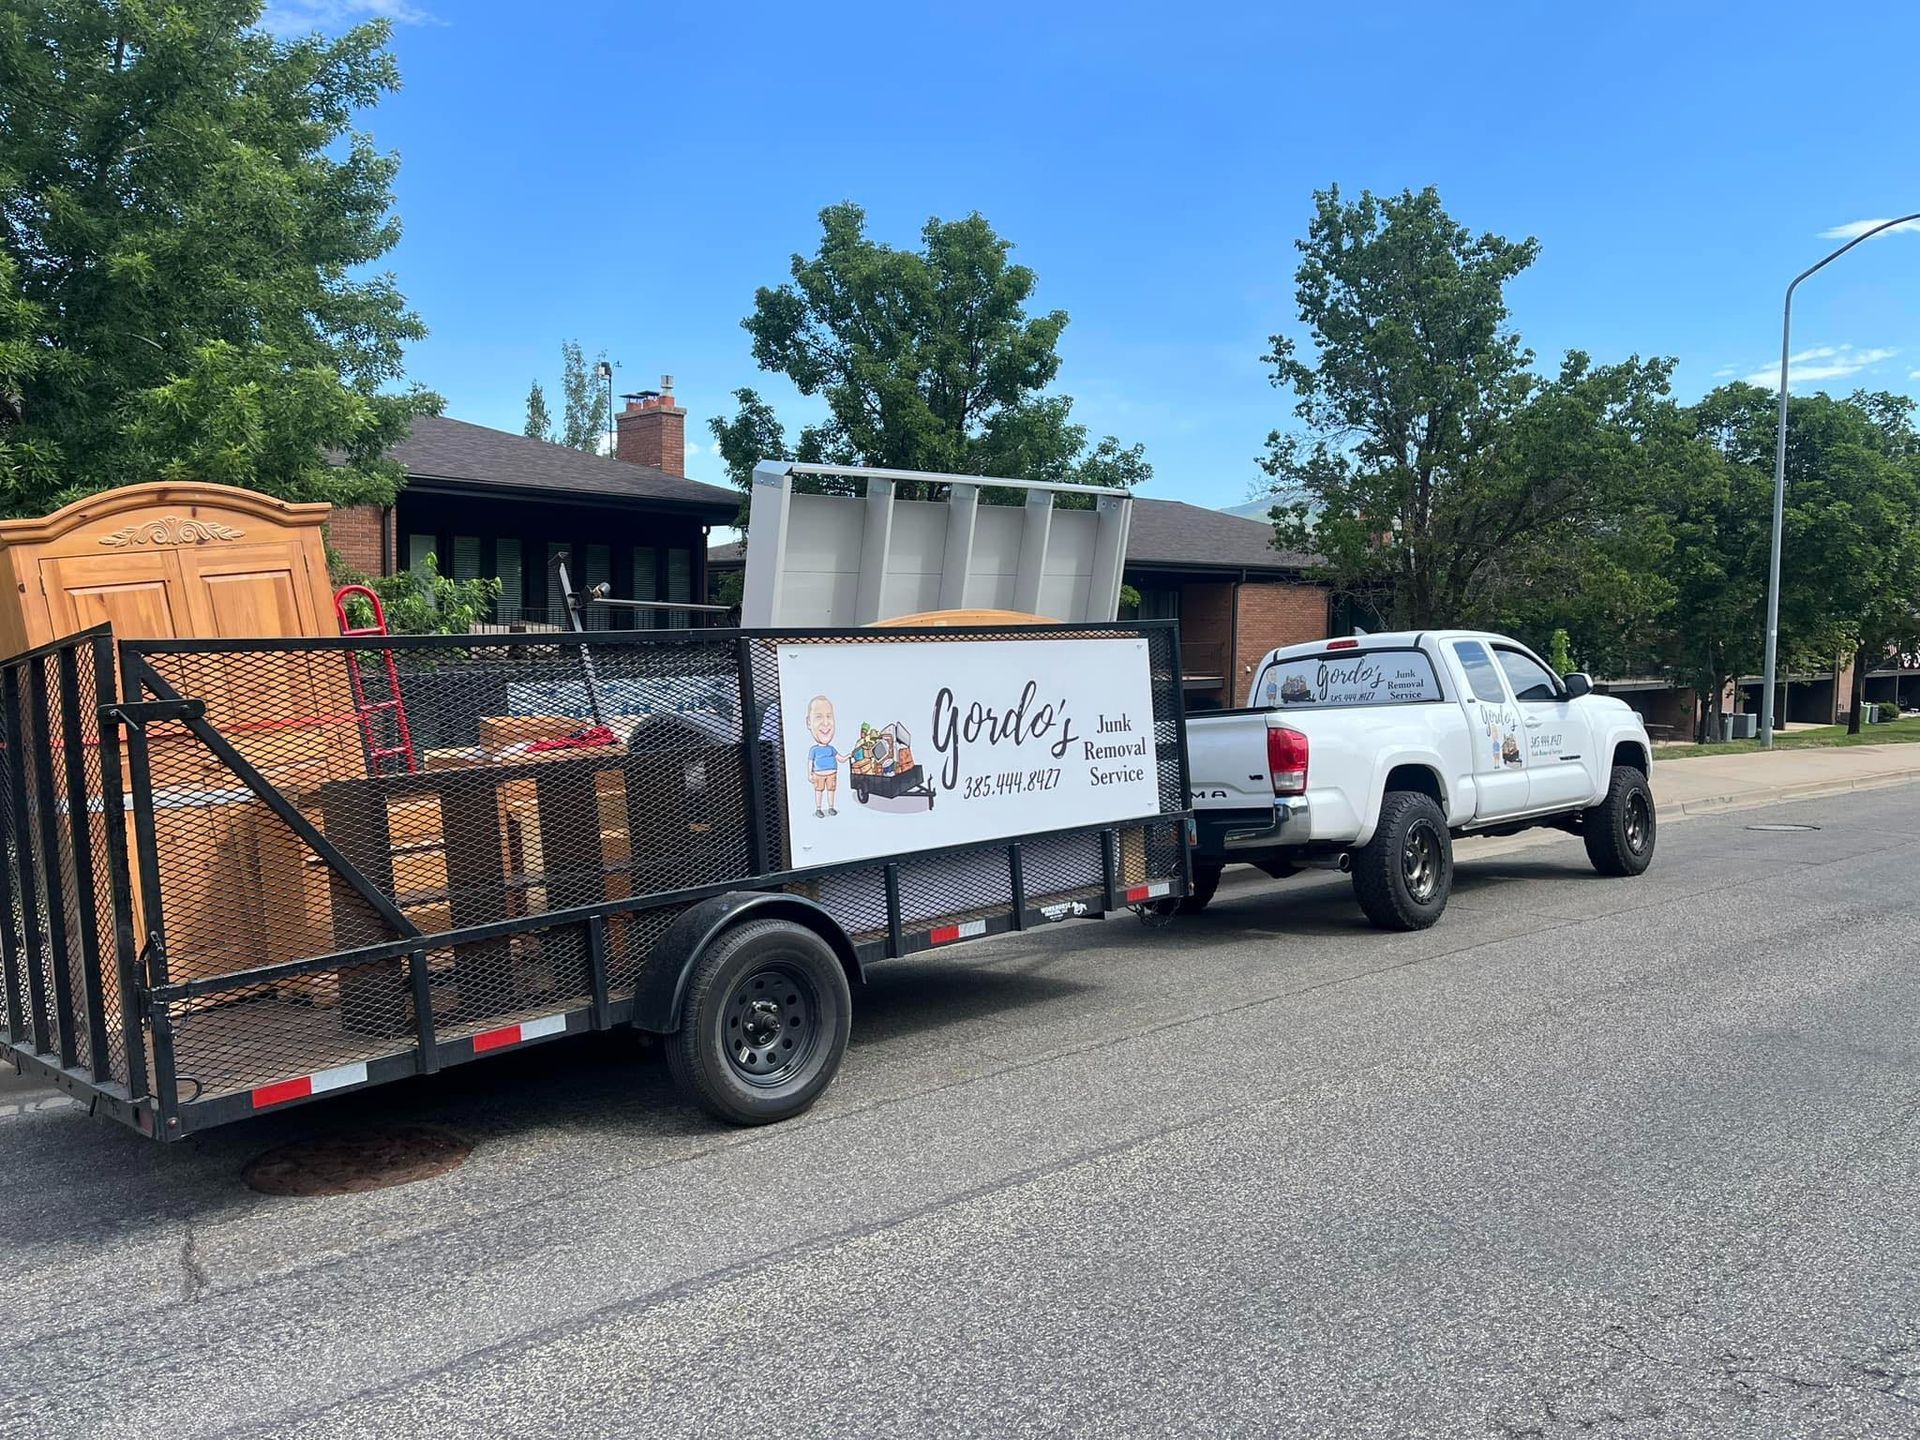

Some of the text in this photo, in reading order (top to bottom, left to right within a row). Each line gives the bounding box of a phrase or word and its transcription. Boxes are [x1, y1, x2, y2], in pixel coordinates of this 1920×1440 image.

[1387, 679, 1424, 690] Removal
[1395, 669, 1416, 679] Junk
[1390, 690, 1422, 700] Service
[1096, 712, 1132, 734] Junk
[1084, 736, 1146, 760] Removal
[964, 768, 1061, 800] 385.444.8427
[1090, 764, 1144, 786] Service
